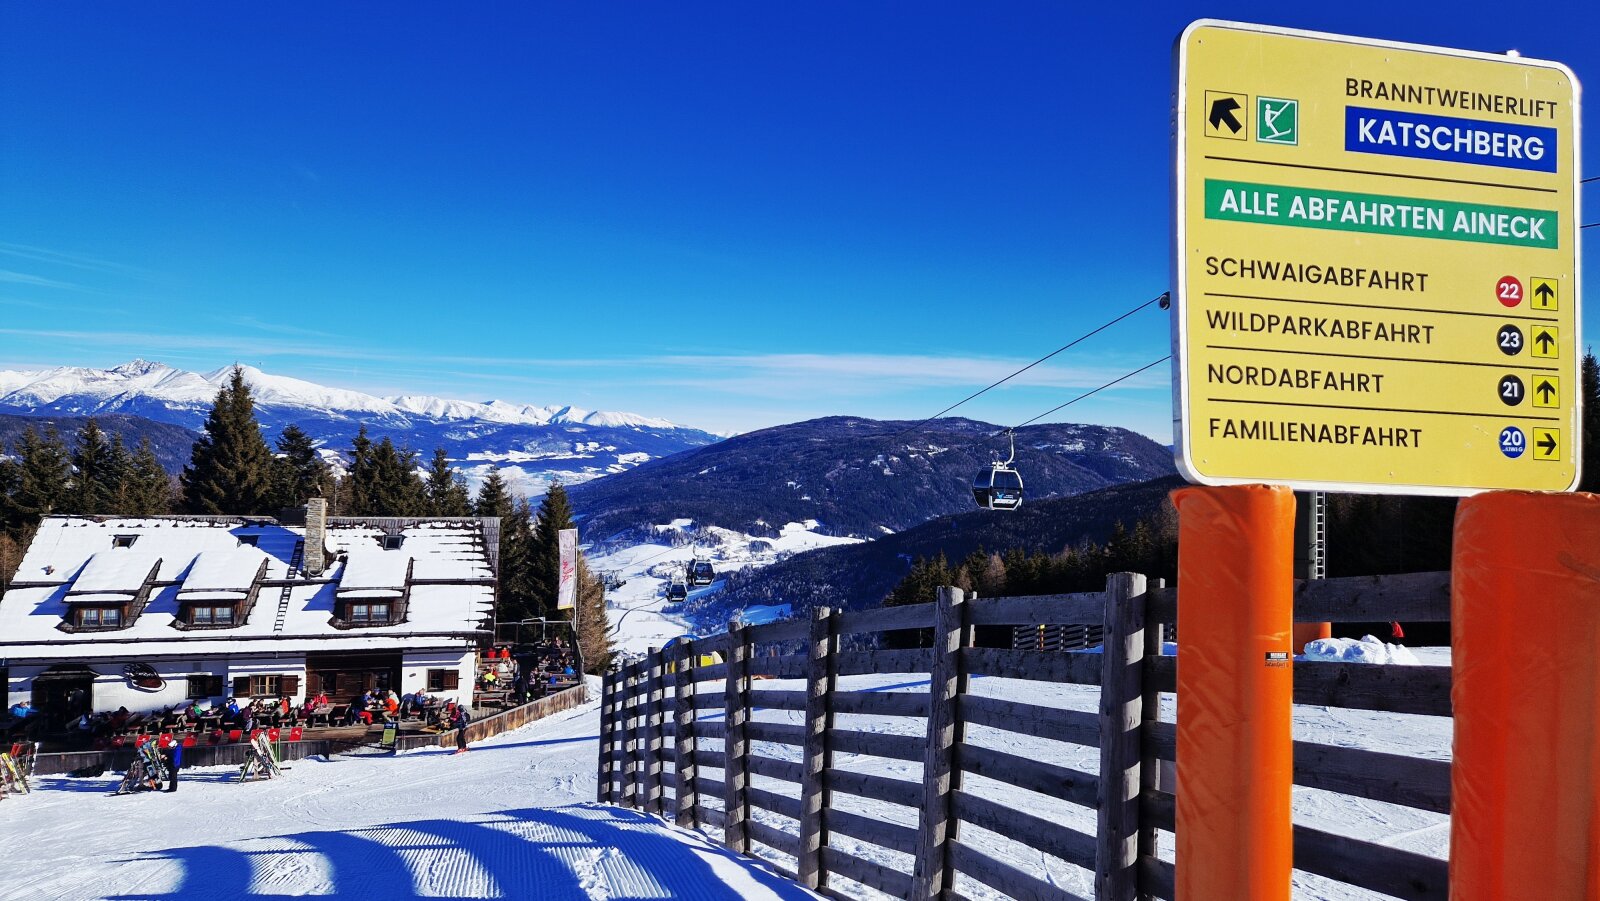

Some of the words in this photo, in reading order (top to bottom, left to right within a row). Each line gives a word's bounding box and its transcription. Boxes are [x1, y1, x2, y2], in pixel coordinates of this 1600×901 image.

[1346, 78, 1557, 119] BRANNTWEINERLIFT
[1359, 118, 1544, 160] KATSCHBERG
[1220, 188, 1279, 217] ALLE
[1289, 196, 1444, 231] ABFAHRTEN
[1453, 210, 1545, 240] AINECK
[1205, 257, 1428, 292] SCHWAIGABFAHRT
[1500, 283, 1518, 299] 22
[1207, 310, 1434, 344] WILDPARKABFAHRT
[1501, 332, 1519, 347] 23
[1208, 364, 1383, 393] NORDABFAHRT
[1503, 382, 1517, 397] 21
[1209, 418, 1421, 447] FAMILIENABFAHRT
[1502, 430, 1522, 446] 20
